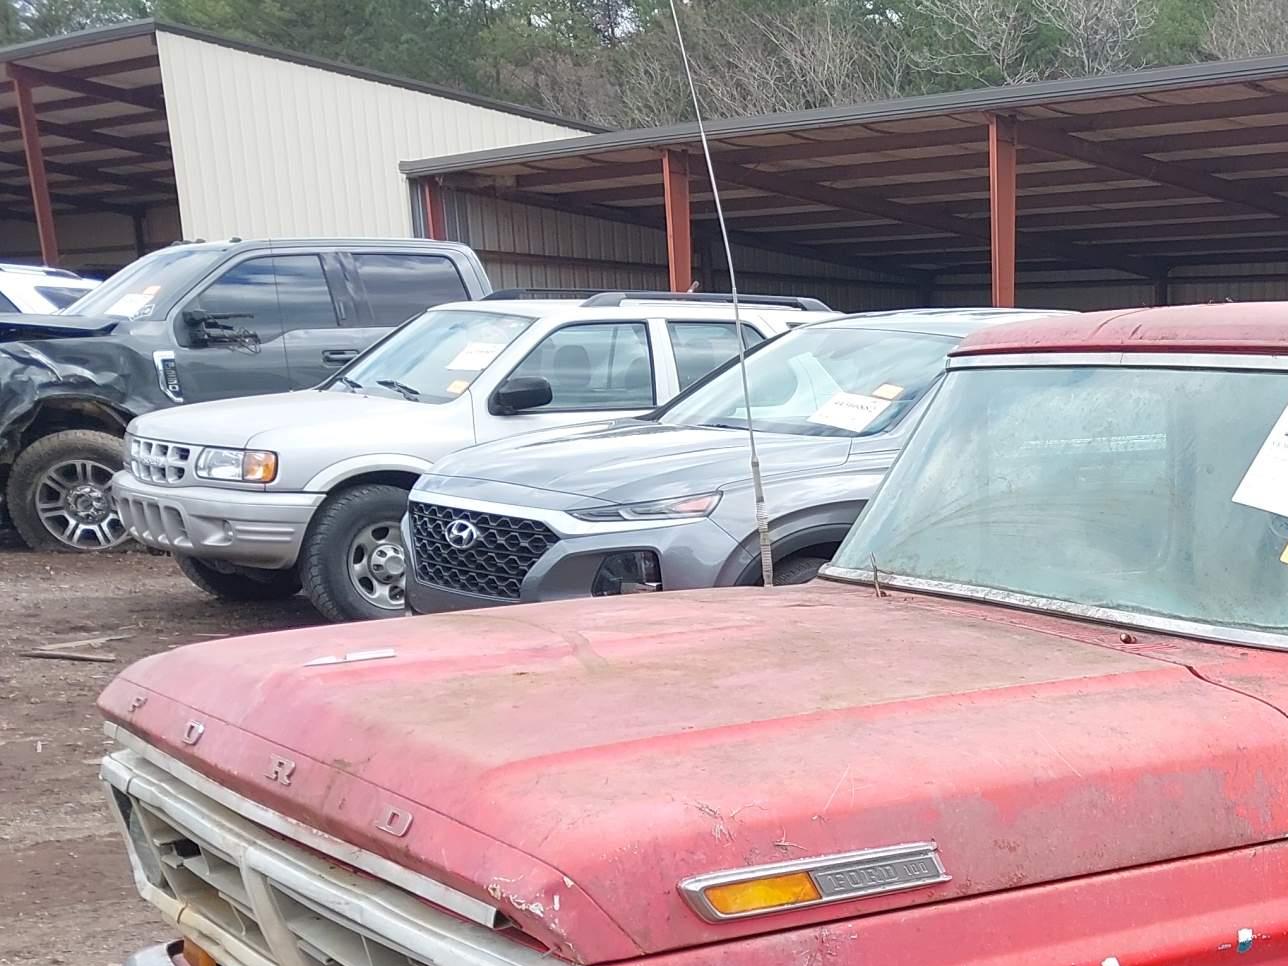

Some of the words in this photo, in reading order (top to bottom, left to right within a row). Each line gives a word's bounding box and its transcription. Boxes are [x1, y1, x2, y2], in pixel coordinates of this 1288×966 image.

[127, 695, 414, 838] FORD
[827, 864, 899, 892] FORD
[903, 861, 928, 877] 100
